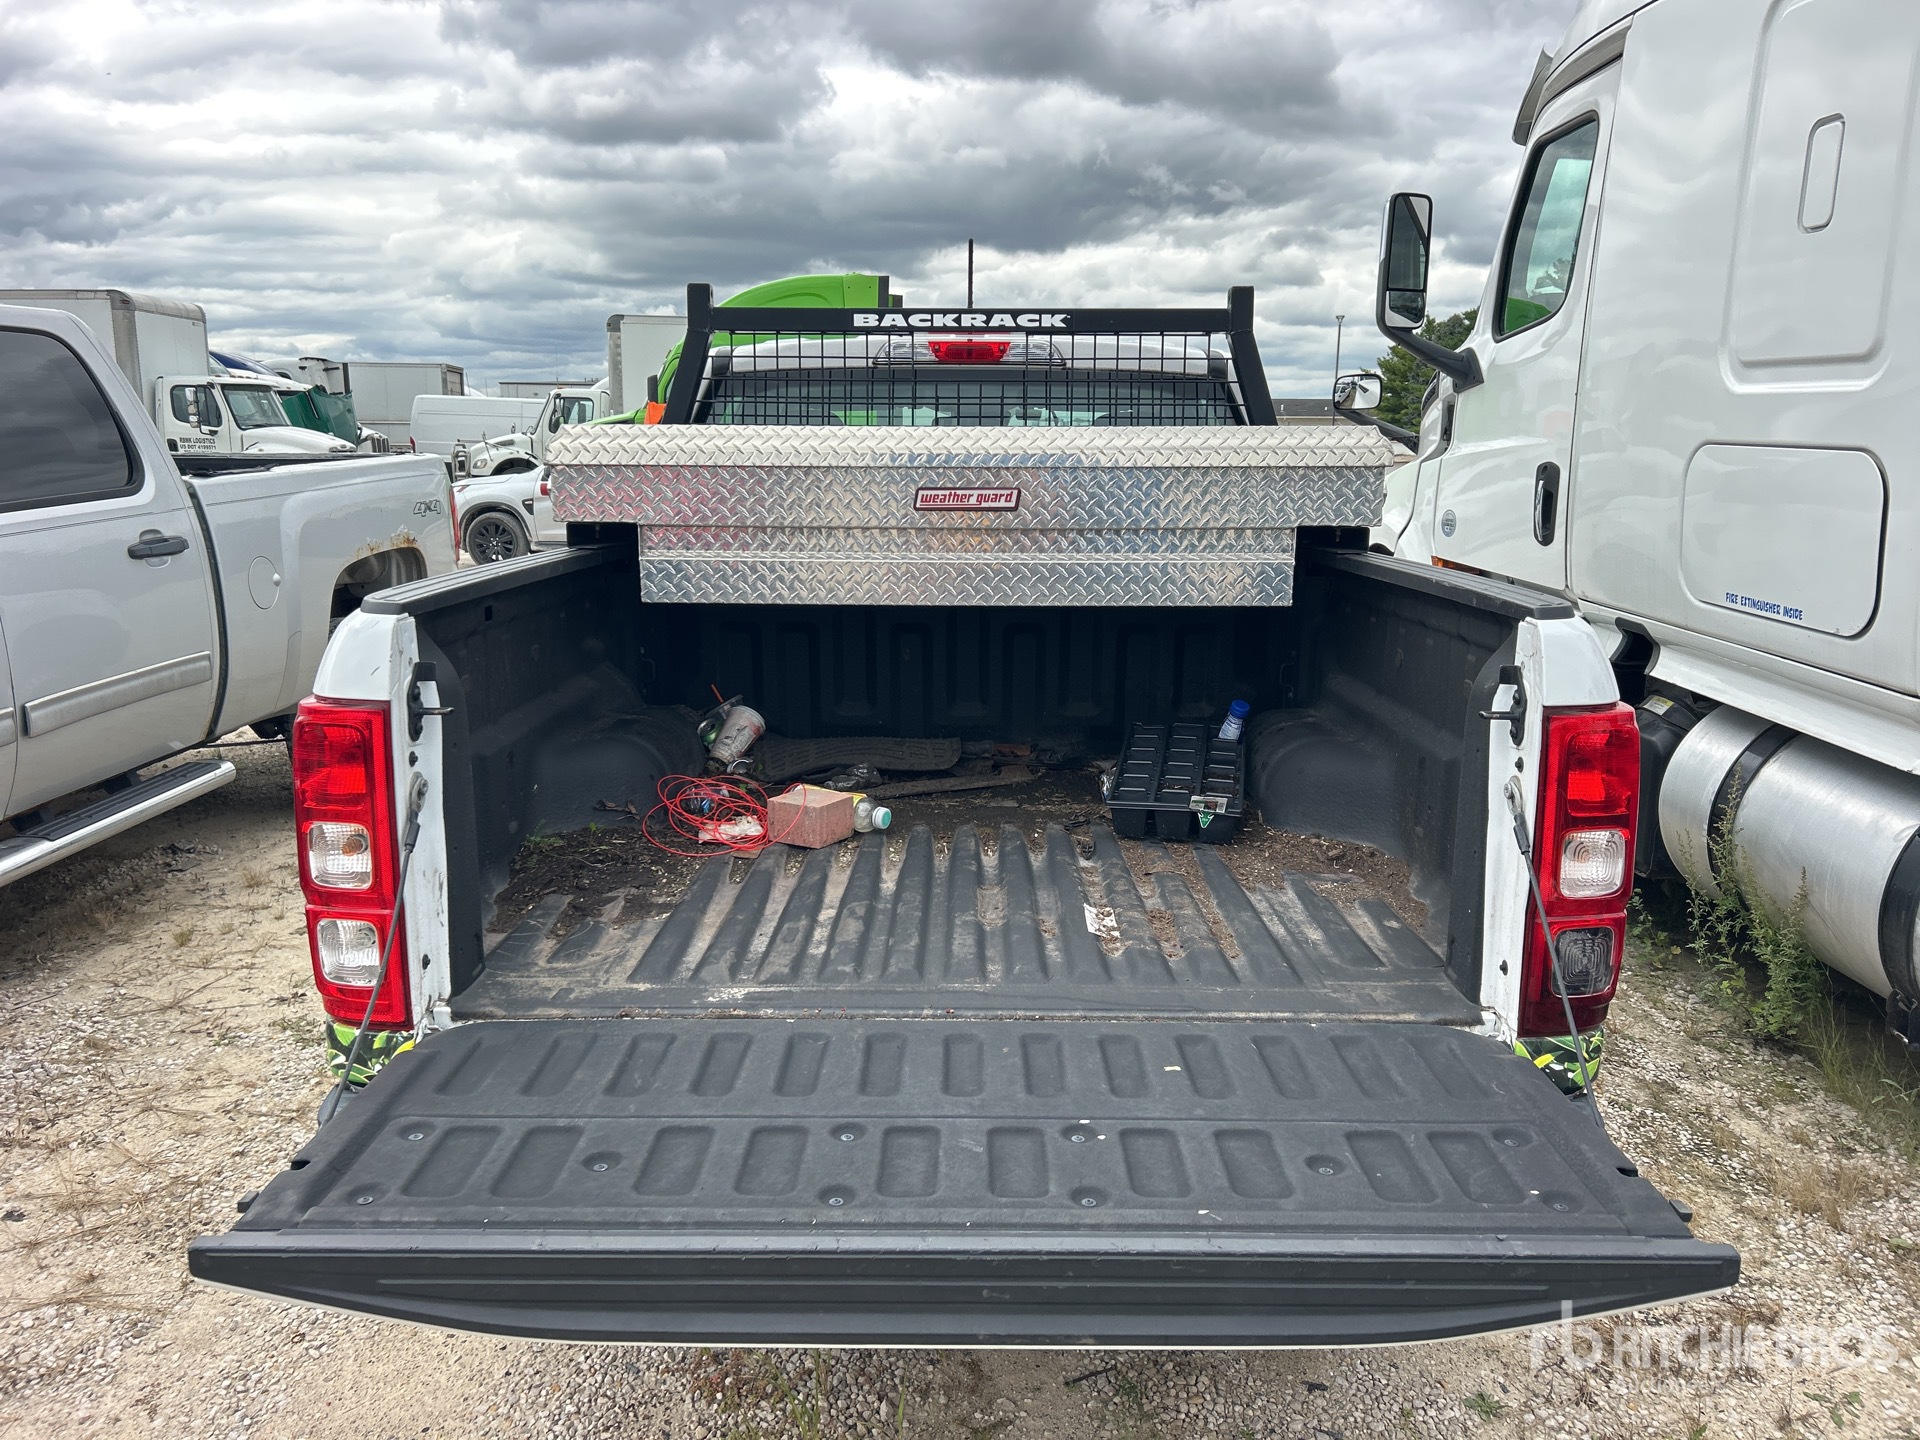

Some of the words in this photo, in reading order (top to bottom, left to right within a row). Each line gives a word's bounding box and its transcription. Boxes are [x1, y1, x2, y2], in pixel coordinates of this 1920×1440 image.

[853, 313, 1067, 328] BACKRACK
[920, 491, 974, 504] weather
[975, 491, 1014, 506] guard
[1725, 592, 1739, 605] FIRE
[1740, 596, 1781, 615] EXTINGUISHER
[1782, 605, 1804, 621] INSIDE
